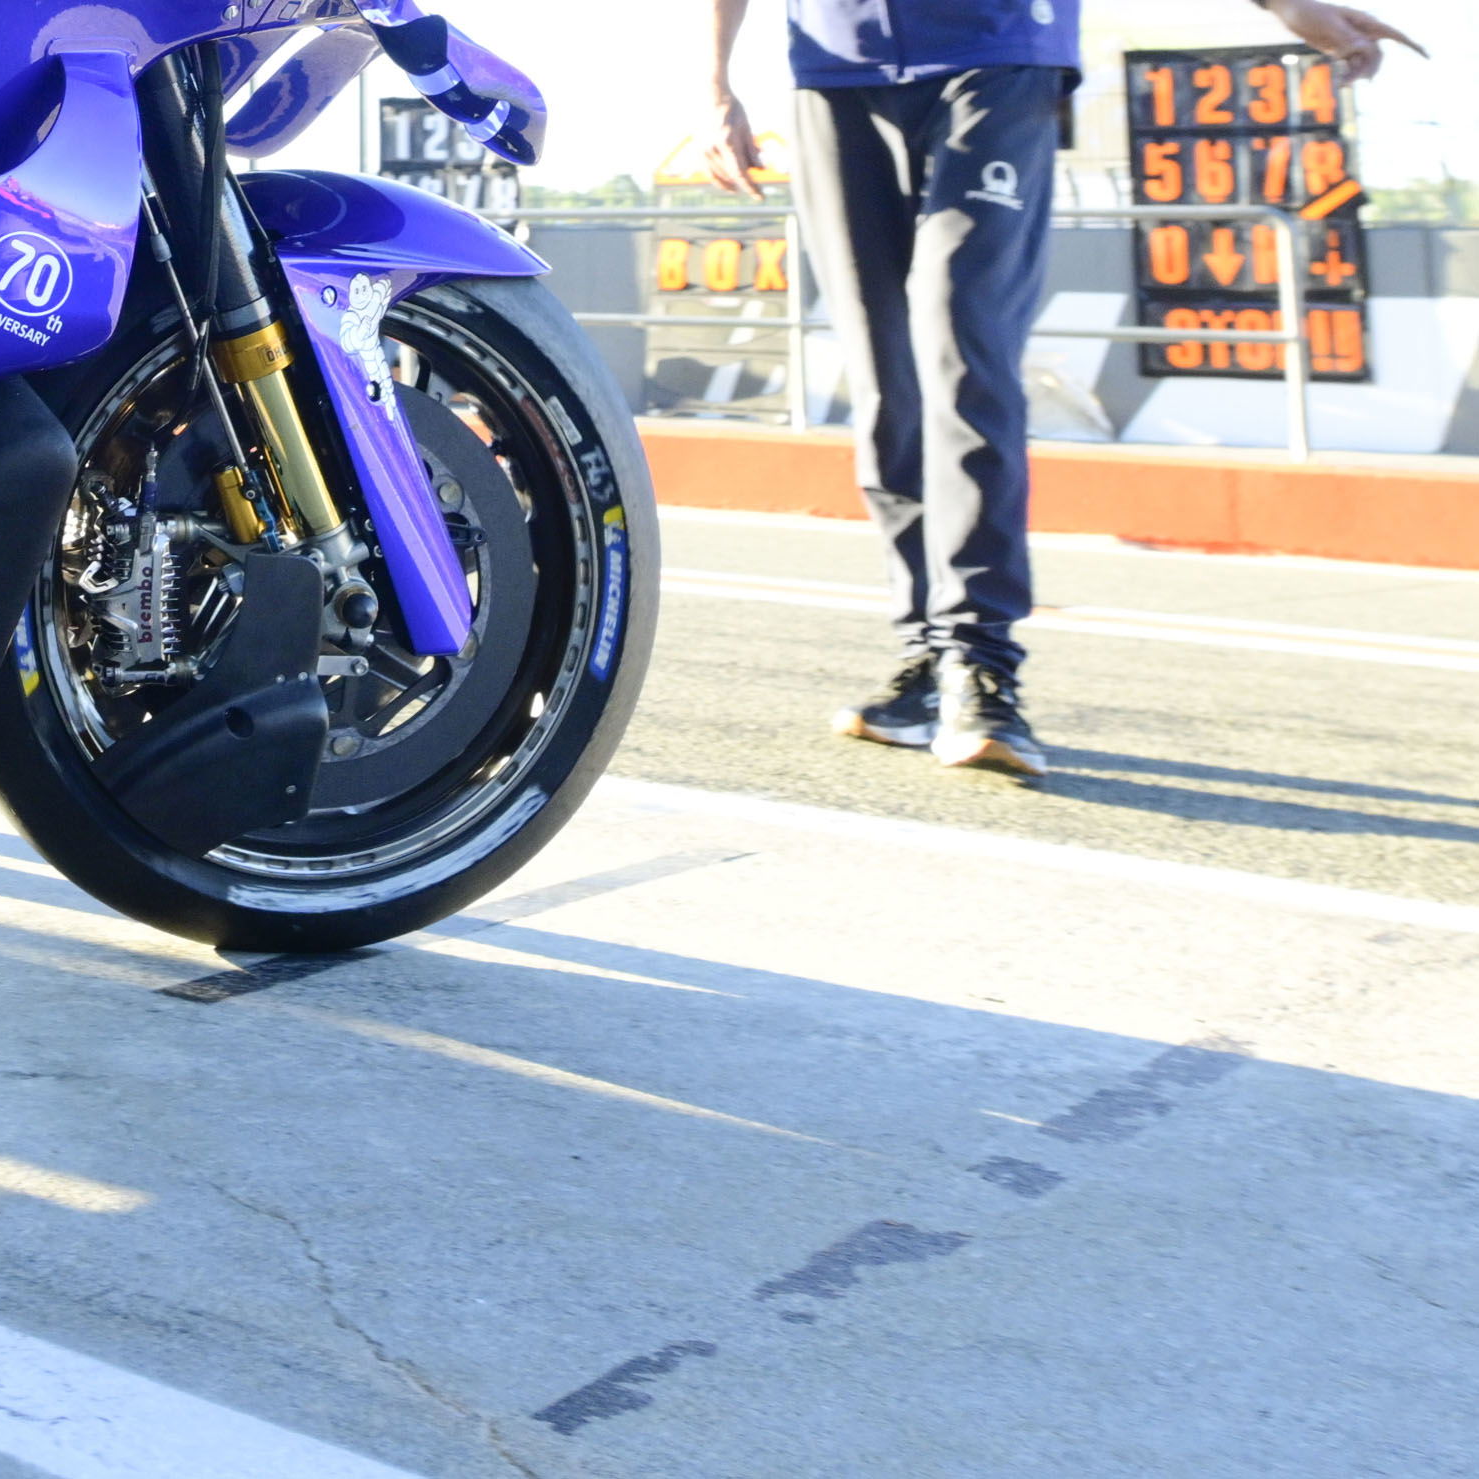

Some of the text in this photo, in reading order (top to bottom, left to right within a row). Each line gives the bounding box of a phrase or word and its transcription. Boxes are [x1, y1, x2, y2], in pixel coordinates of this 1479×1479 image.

[656, 237, 786, 292] BOX
[46, 314, 63, 334] th
[137, 566, 154, 644] brembo
[593, 549, 623, 671] MICHELIN
